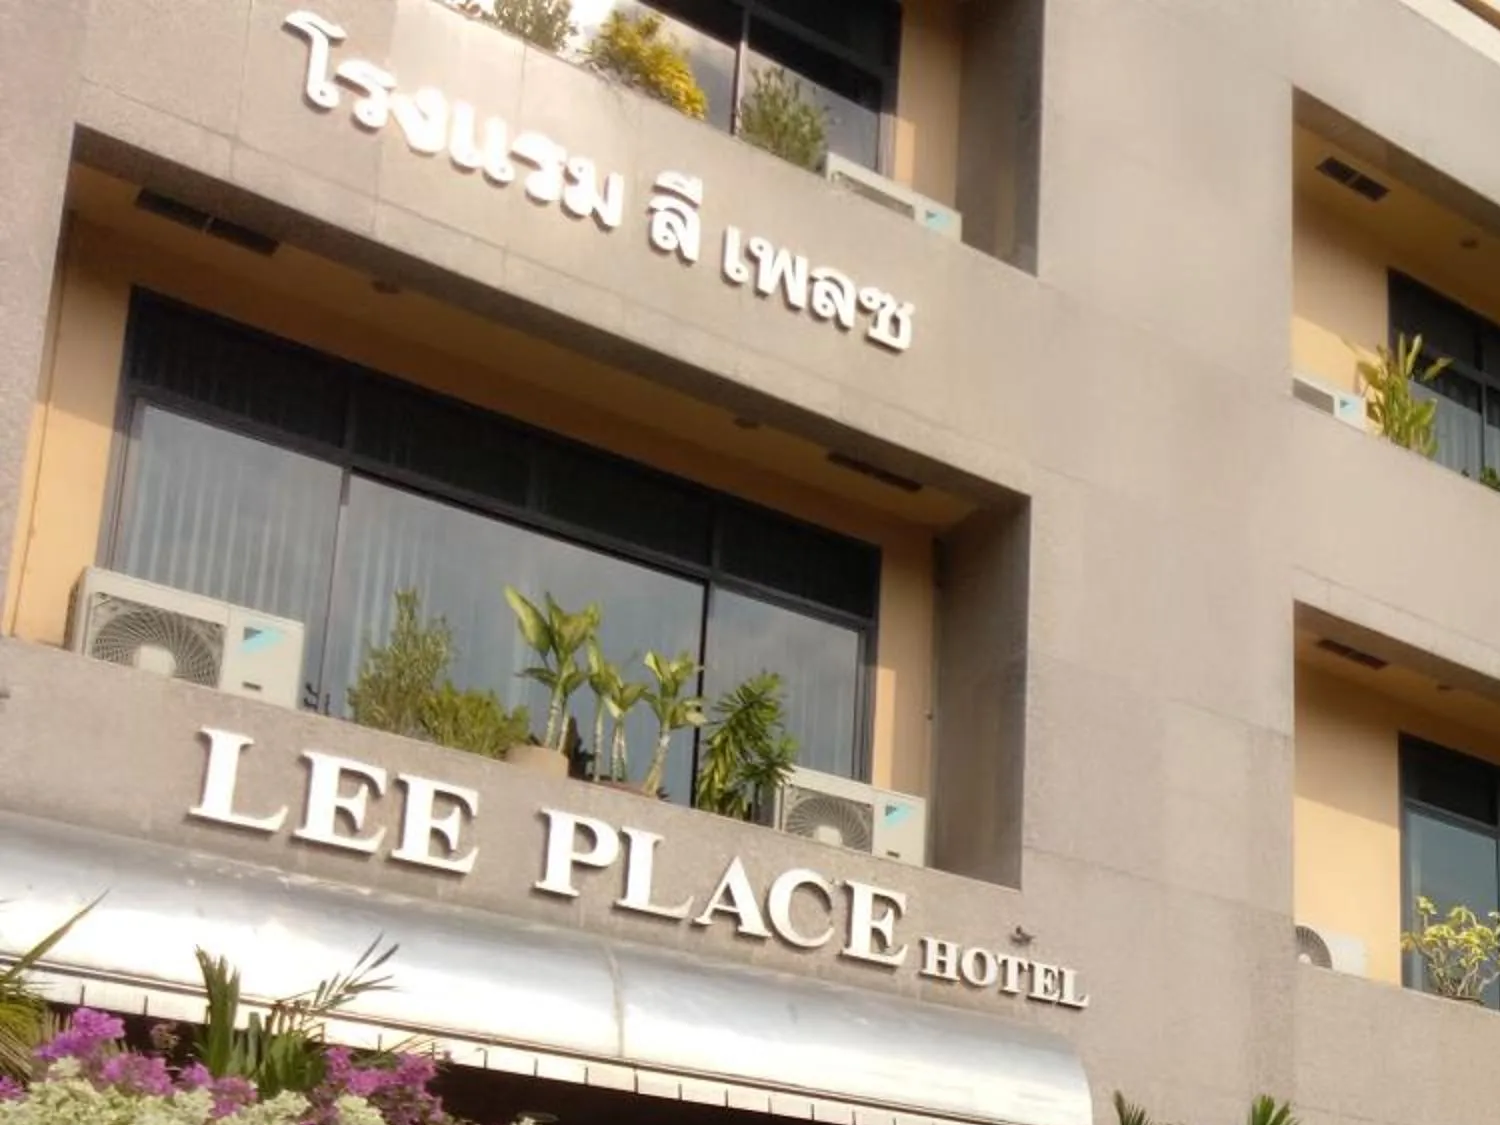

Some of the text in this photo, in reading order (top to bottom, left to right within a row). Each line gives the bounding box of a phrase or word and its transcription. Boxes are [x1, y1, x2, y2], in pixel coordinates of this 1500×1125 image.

[282, 10, 625, 229] โรงแรม
[722, 224, 915, 351] เพลซ
[188, 726, 1089, 1008] LEE PLACE HOTEL
